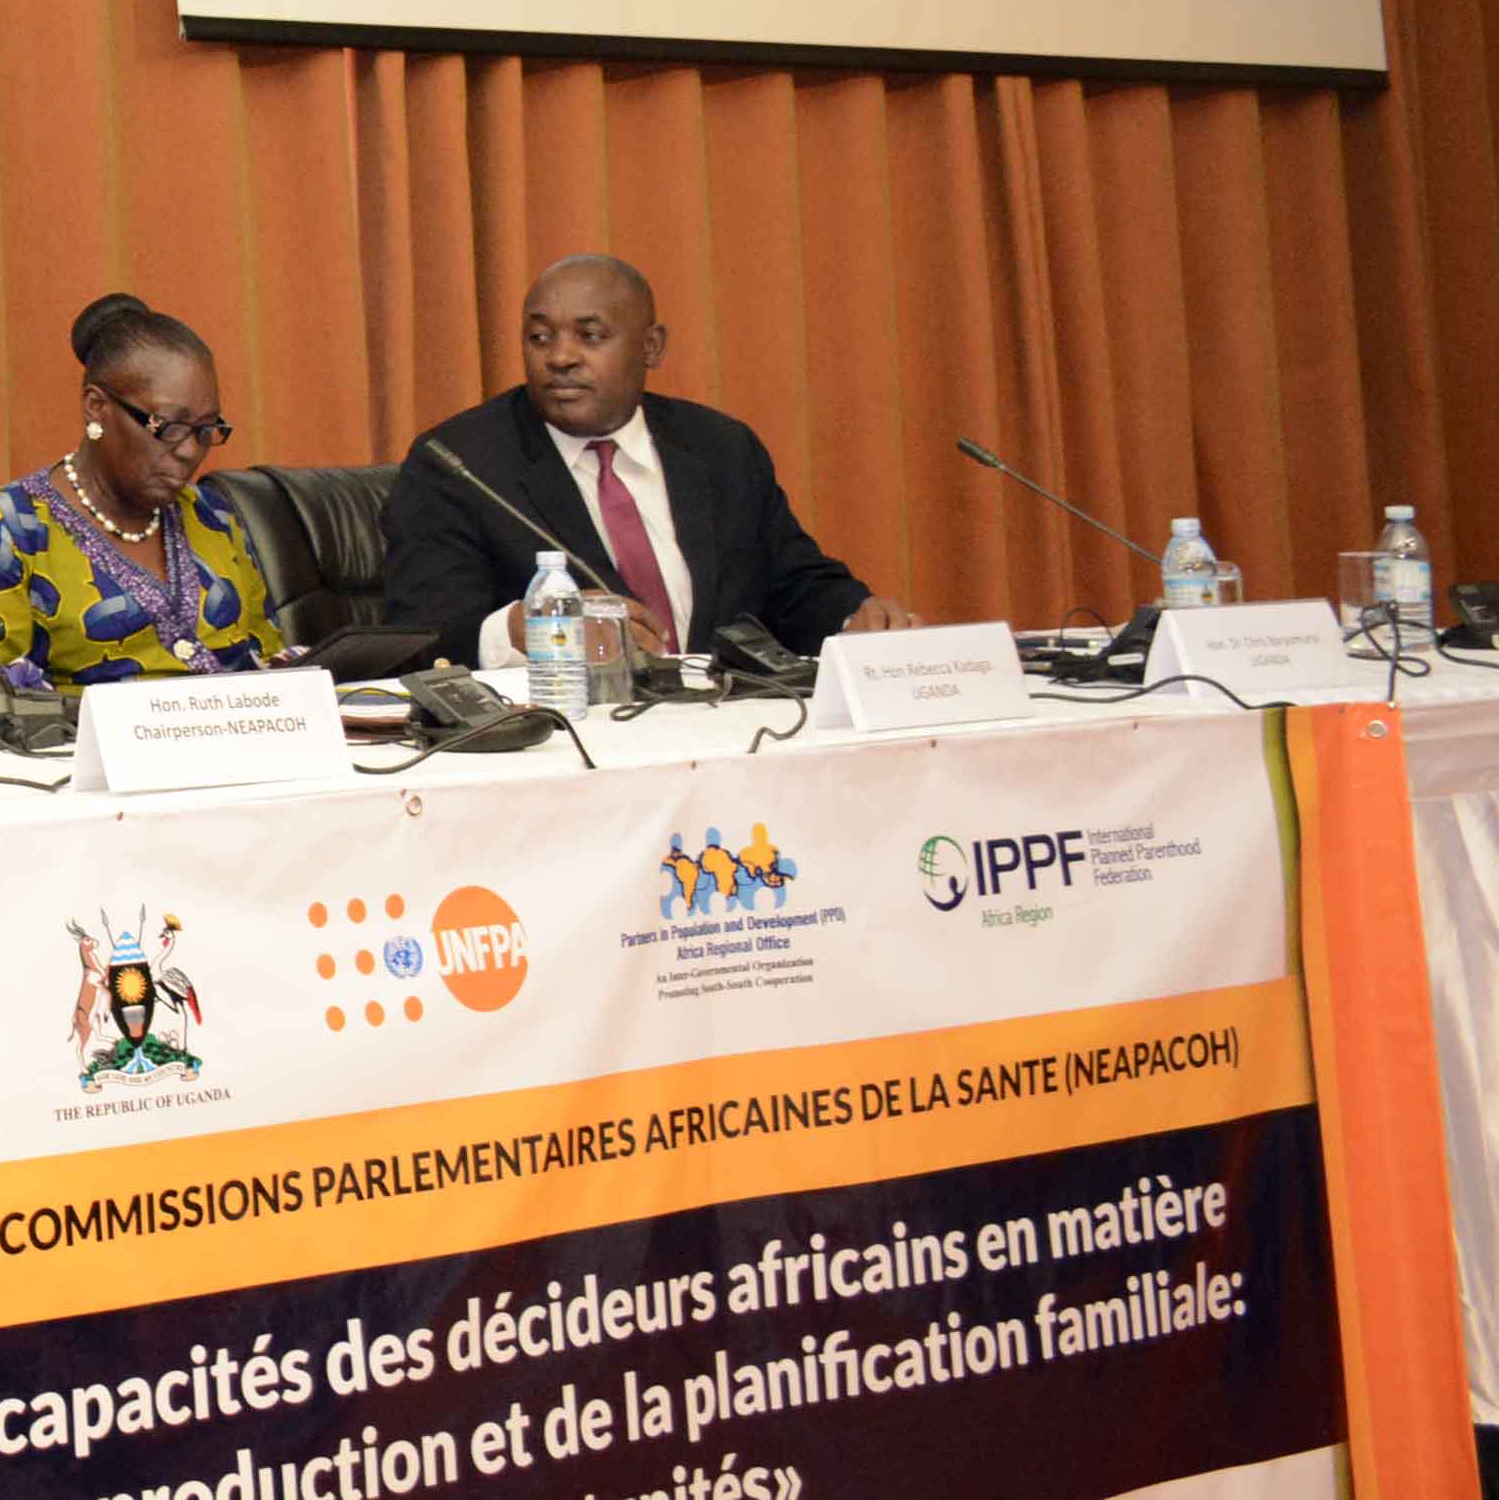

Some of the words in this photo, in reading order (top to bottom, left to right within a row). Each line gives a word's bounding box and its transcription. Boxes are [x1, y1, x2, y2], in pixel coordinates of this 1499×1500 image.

[150, 698, 182, 713] Hon.
[188, 695, 223, 710] Ruth
[227, 692, 279, 708] Labode
[134, 717, 307, 740] Chairperson-NEAPACOH
[1087, 823, 1155, 845] International
[974, 831, 1085, 895] IPPF
[1091, 846, 1134, 865] Planned
[1135, 838, 1201, 860] Parenthood
[1093, 868, 1152, 885] Federation
[982, 910, 1013, 927] Africa
[1015, 905, 1053, 927] Region
[433, 921, 527, 976] UNFPA
[54, 1107, 82, 1122] THE
[86, 1099, 153, 1117] REPUBLIC
[155, 1097, 173, 1109] OF
[176, 1088, 232, 1106] UGANDA
[313, 1118, 635, 1207] PARLEMENTAIRES
[645, 1087, 852, 1153] AFRICAINES
[861, 1080, 902, 1120] DE
[910, 1074, 950, 1113] LA
[958, 1057, 1058, 1105] SANTE
[1066, 1028, 1238, 1095] (NEAPACOH)
[327, 1319, 434, 1394] des
[448, 1272, 715, 1371] décideurs
[728, 1222, 967, 1313] africains
[978, 1218, 1037, 1271] en
[1048, 1175, 1225, 1258] matière
[471, 1403, 533, 1474] et
[545, 1384, 612, 1459] de
[625, 1371, 672, 1441] la
[685, 1296, 1028, 1442] planification
[1035, 1262, 1245, 1359] familiale:
